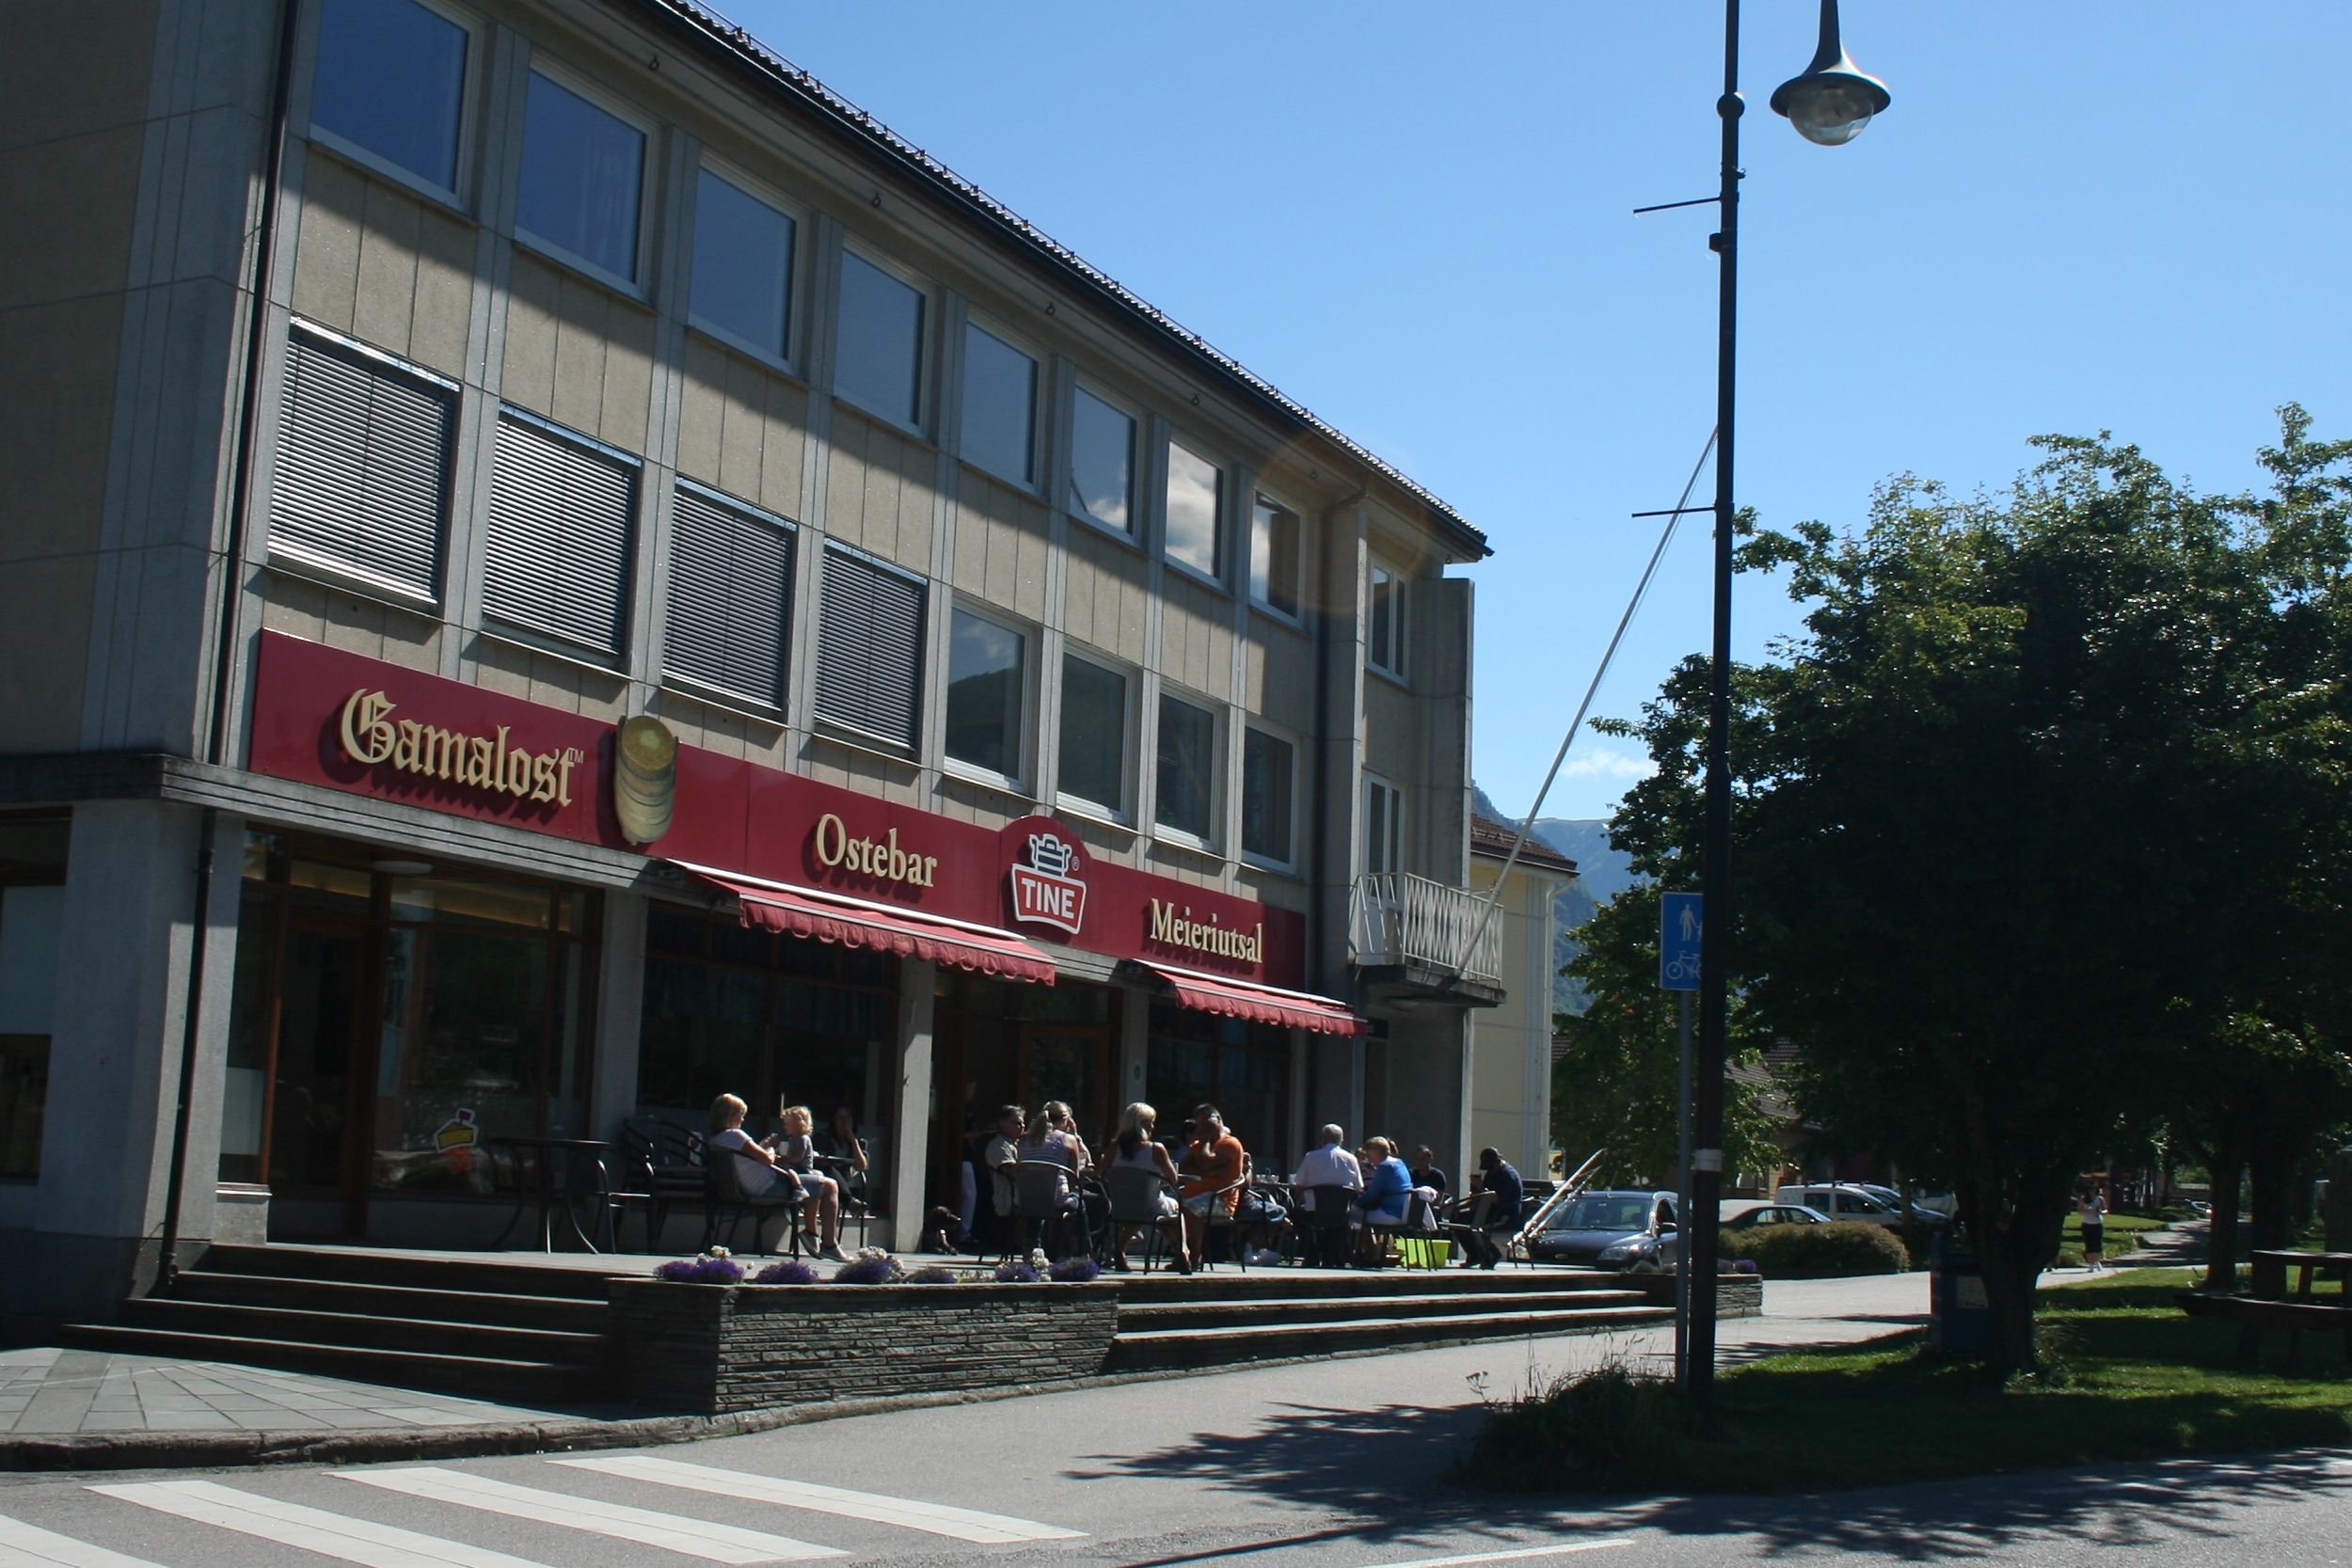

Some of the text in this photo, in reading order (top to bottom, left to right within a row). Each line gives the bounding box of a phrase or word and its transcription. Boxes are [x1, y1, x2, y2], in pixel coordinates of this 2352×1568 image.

[342, 688, 572, 807] Gamalost
[817, 814, 937, 887] Ostebar
[1021, 878, 1074, 919] TINE
[1150, 897, 1263, 963] Meieriutsal
